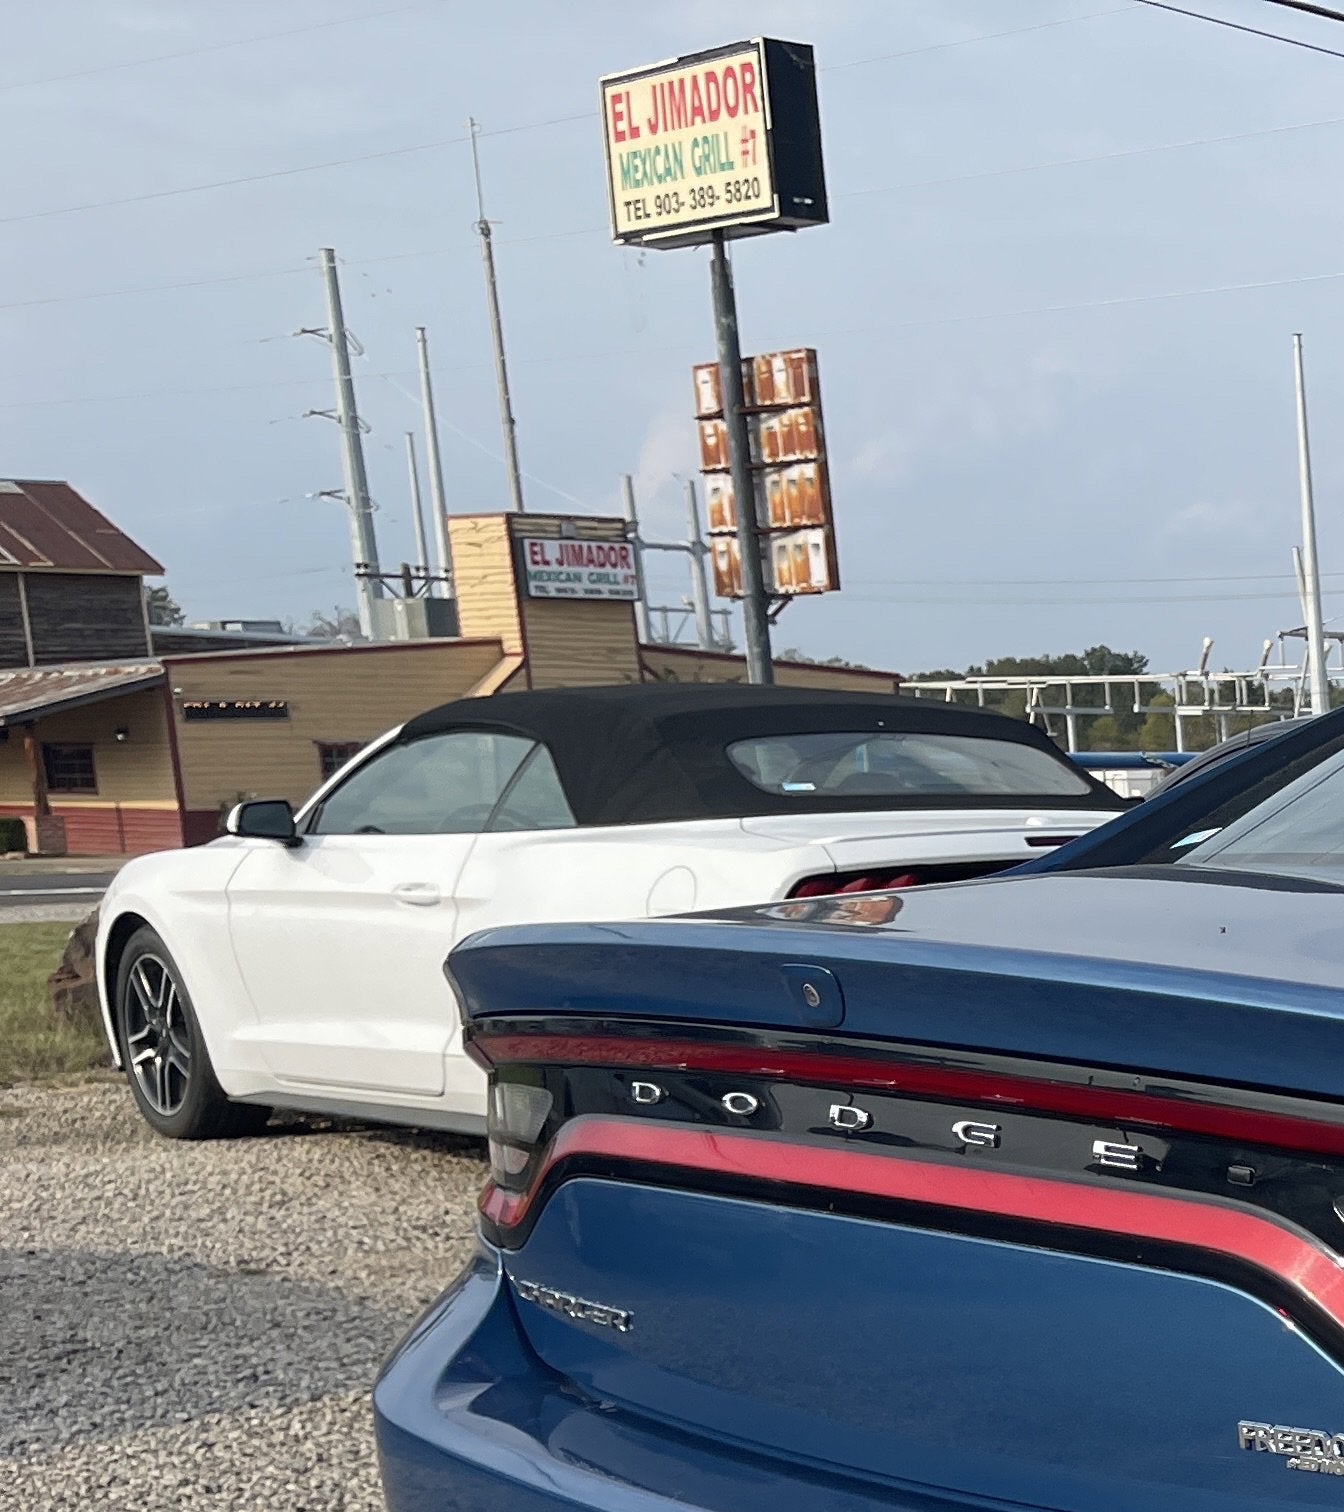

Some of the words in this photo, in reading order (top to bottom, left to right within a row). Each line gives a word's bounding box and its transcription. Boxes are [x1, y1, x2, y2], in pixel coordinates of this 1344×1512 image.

[610, 91, 640, 143] EL
[647, 61, 760, 136] JIMADOR
[619, 140, 686, 191] MEXICAN
[691, 131, 735, 178] GRILL
[623, 200, 652, 222] TEL
[655, 191, 686, 216] 903-
[689, 185, 720, 210] 389-
[725, 177, 761, 204] 5820
[527, 570, 582, 583] MEXICAN
[587, 572, 620, 585] GRILL
[529, 541, 550, 567] EL
[555, 543, 632, 569] JIMADOR
[630, 1080, 1141, 1171] DODGE
